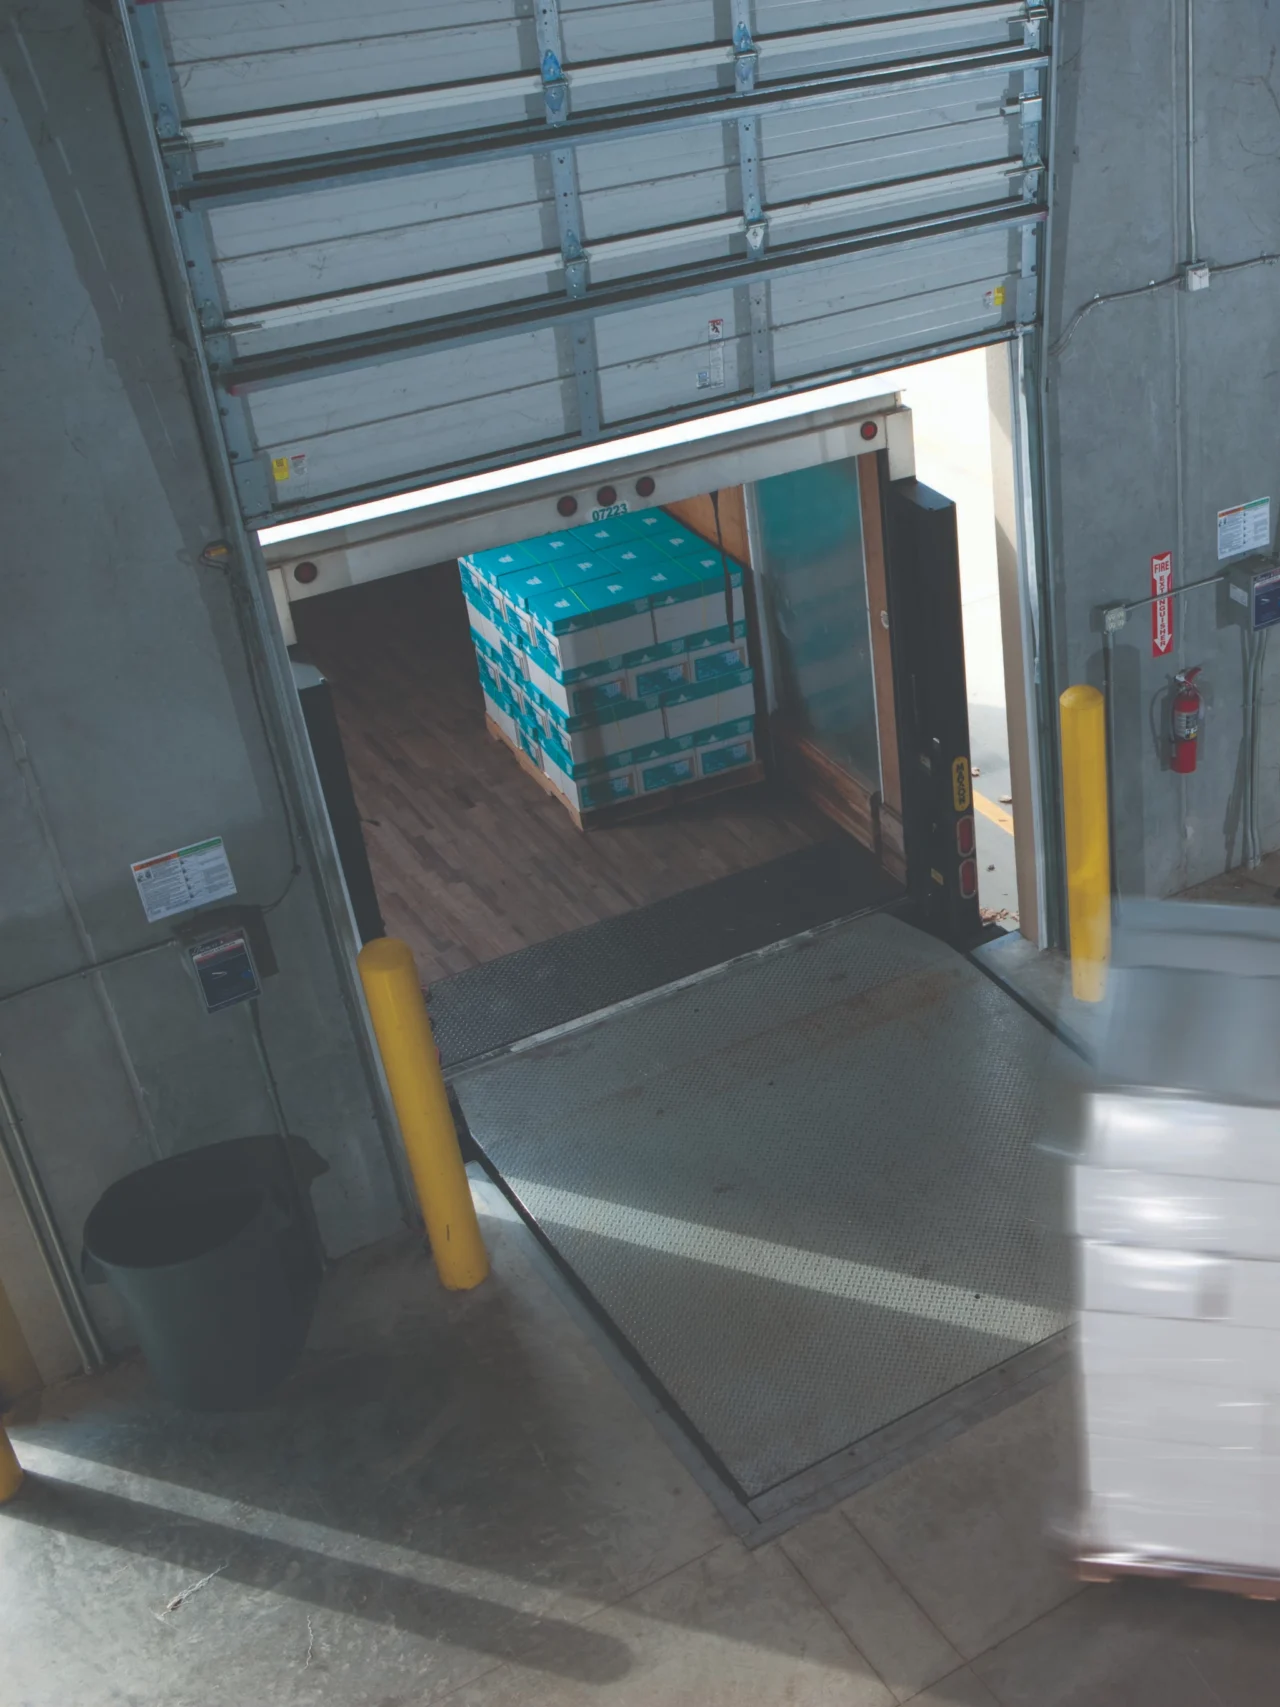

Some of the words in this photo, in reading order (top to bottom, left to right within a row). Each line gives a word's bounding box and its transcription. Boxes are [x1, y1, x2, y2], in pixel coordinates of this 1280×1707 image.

[592, 503, 628, 521] 07223
[1154, 560, 1170, 574] FIRE
[1159, 575, 1167, 647] EXTNGUISHER
